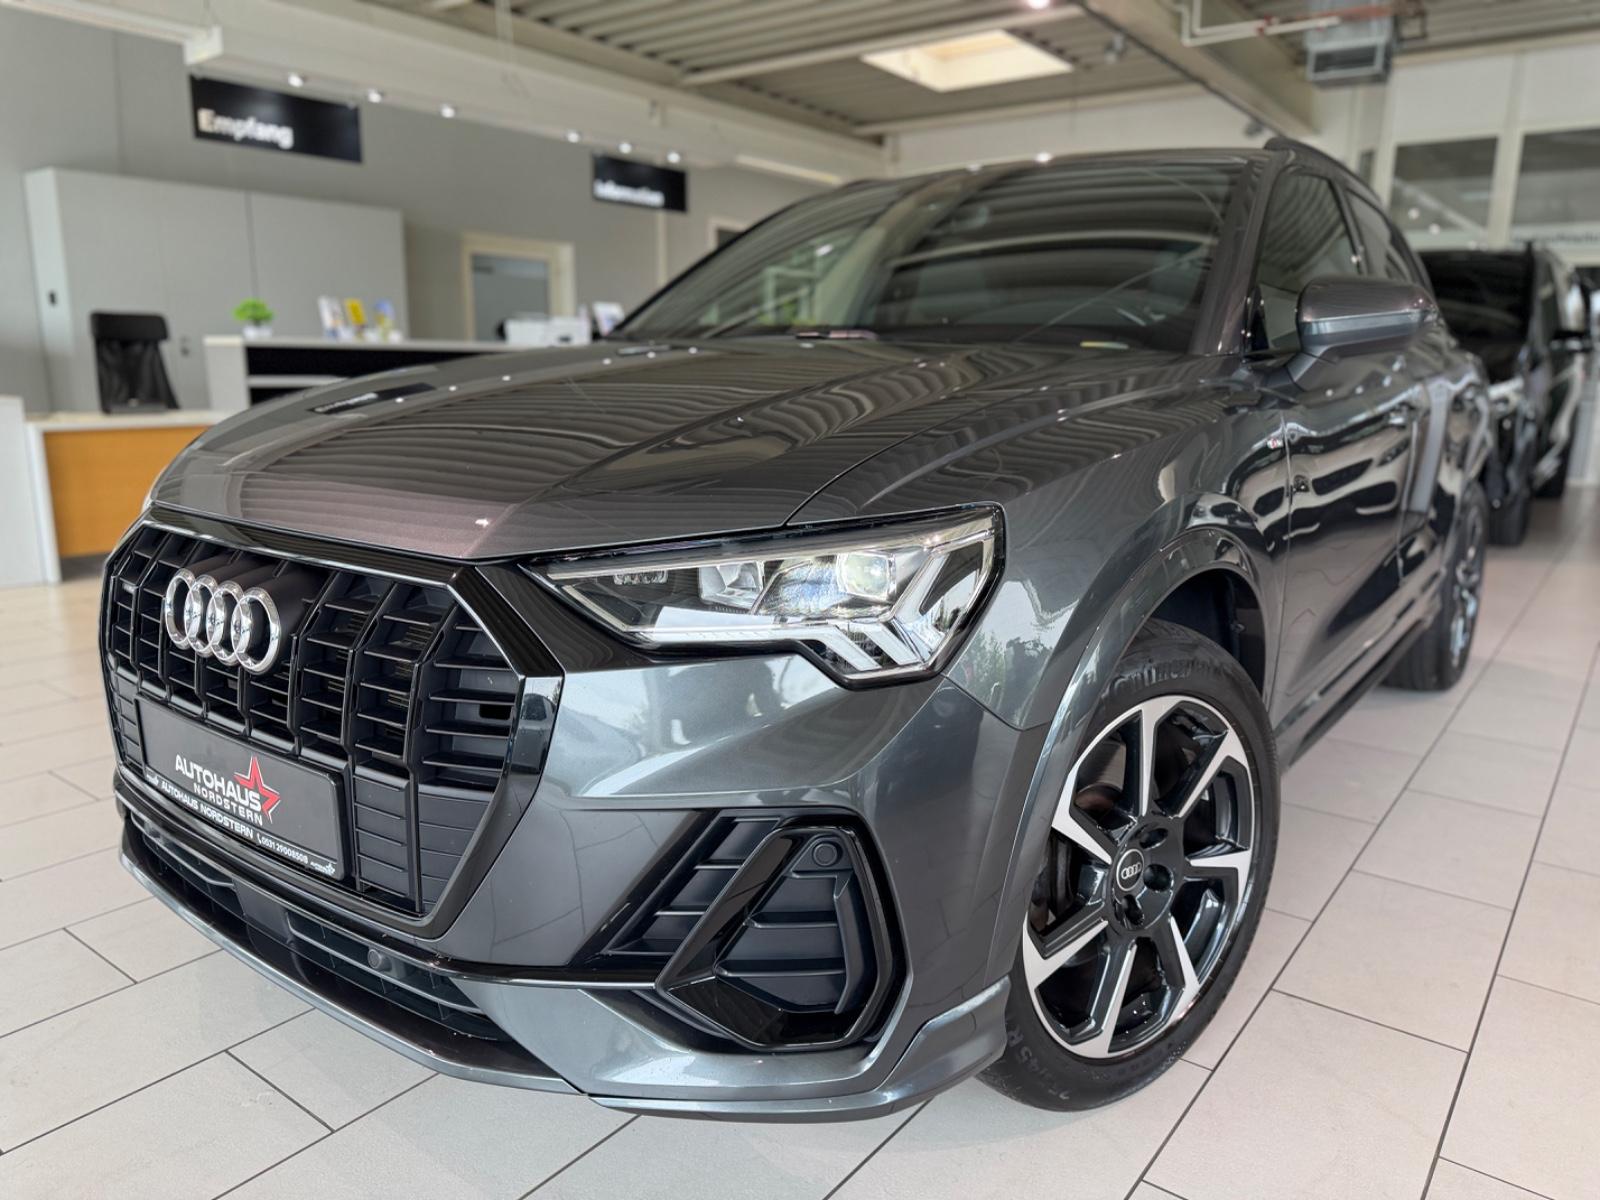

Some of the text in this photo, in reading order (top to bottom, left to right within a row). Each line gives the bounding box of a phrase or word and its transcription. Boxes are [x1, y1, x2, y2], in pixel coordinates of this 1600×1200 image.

[197, 108, 294, 149] Empfang
[175, 754, 262, 811] AUTOHAUS
[193, 783, 263, 826] NORDSTERN
[161, 781, 199, 811] AUTOHAUS
[200, 804, 254, 839] NORDSTERN
